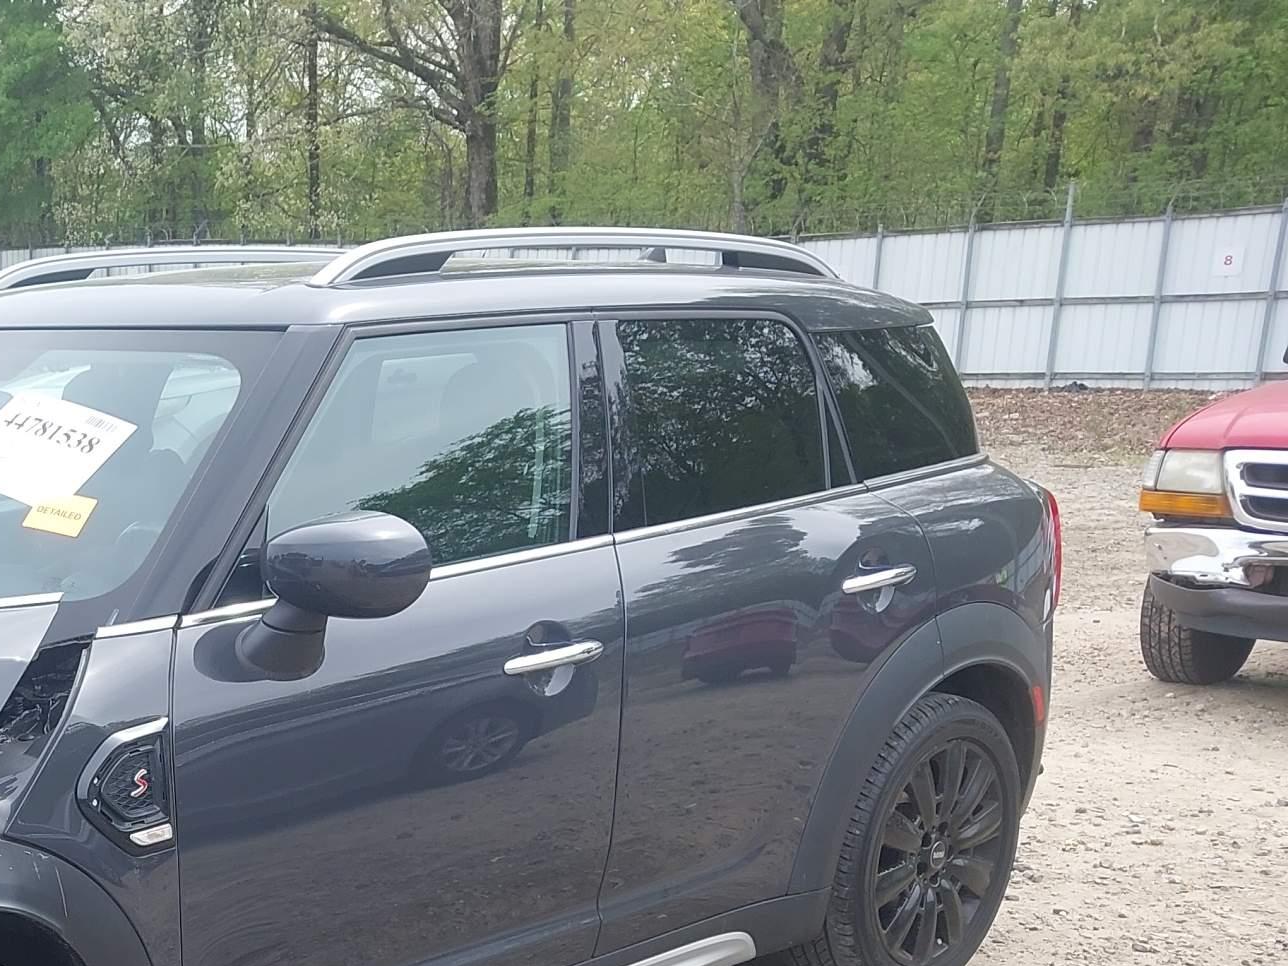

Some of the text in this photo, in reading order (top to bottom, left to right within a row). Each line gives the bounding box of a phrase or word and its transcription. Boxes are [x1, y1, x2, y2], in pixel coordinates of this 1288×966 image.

[1223, 254, 1233, 266] 8
[3, 412, 101, 454] 44781538
[36, 504, 82, 521] DETAILED
[130, 768, 148, 797] S
